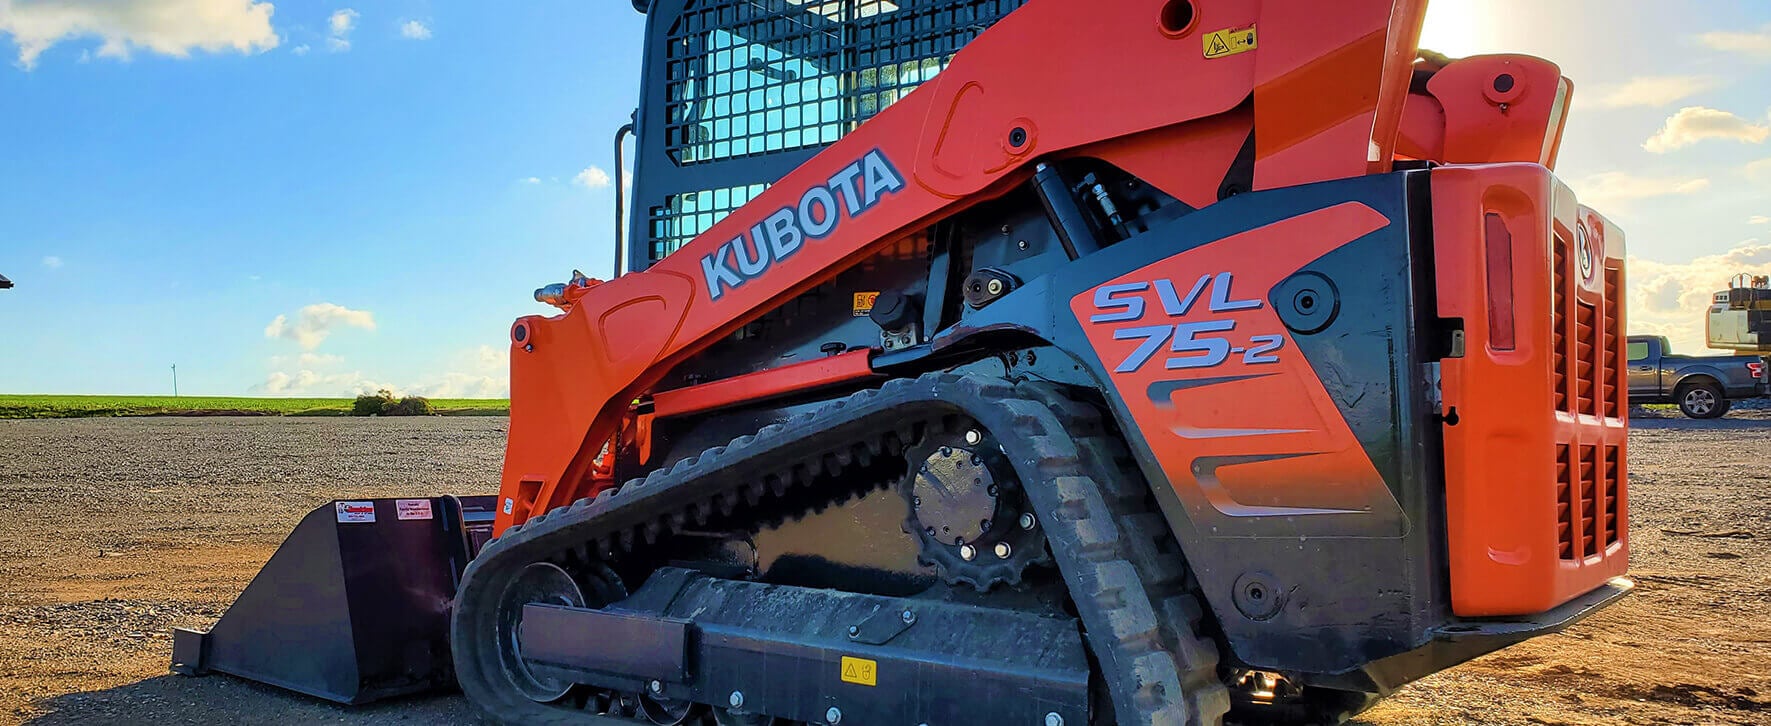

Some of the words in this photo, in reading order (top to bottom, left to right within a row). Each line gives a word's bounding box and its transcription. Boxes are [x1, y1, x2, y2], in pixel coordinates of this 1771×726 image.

[701, 149, 904, 299] KUBOTA
[1090, 272, 1264, 323] SVL
[1113, 319, 1285, 373] 75-2
